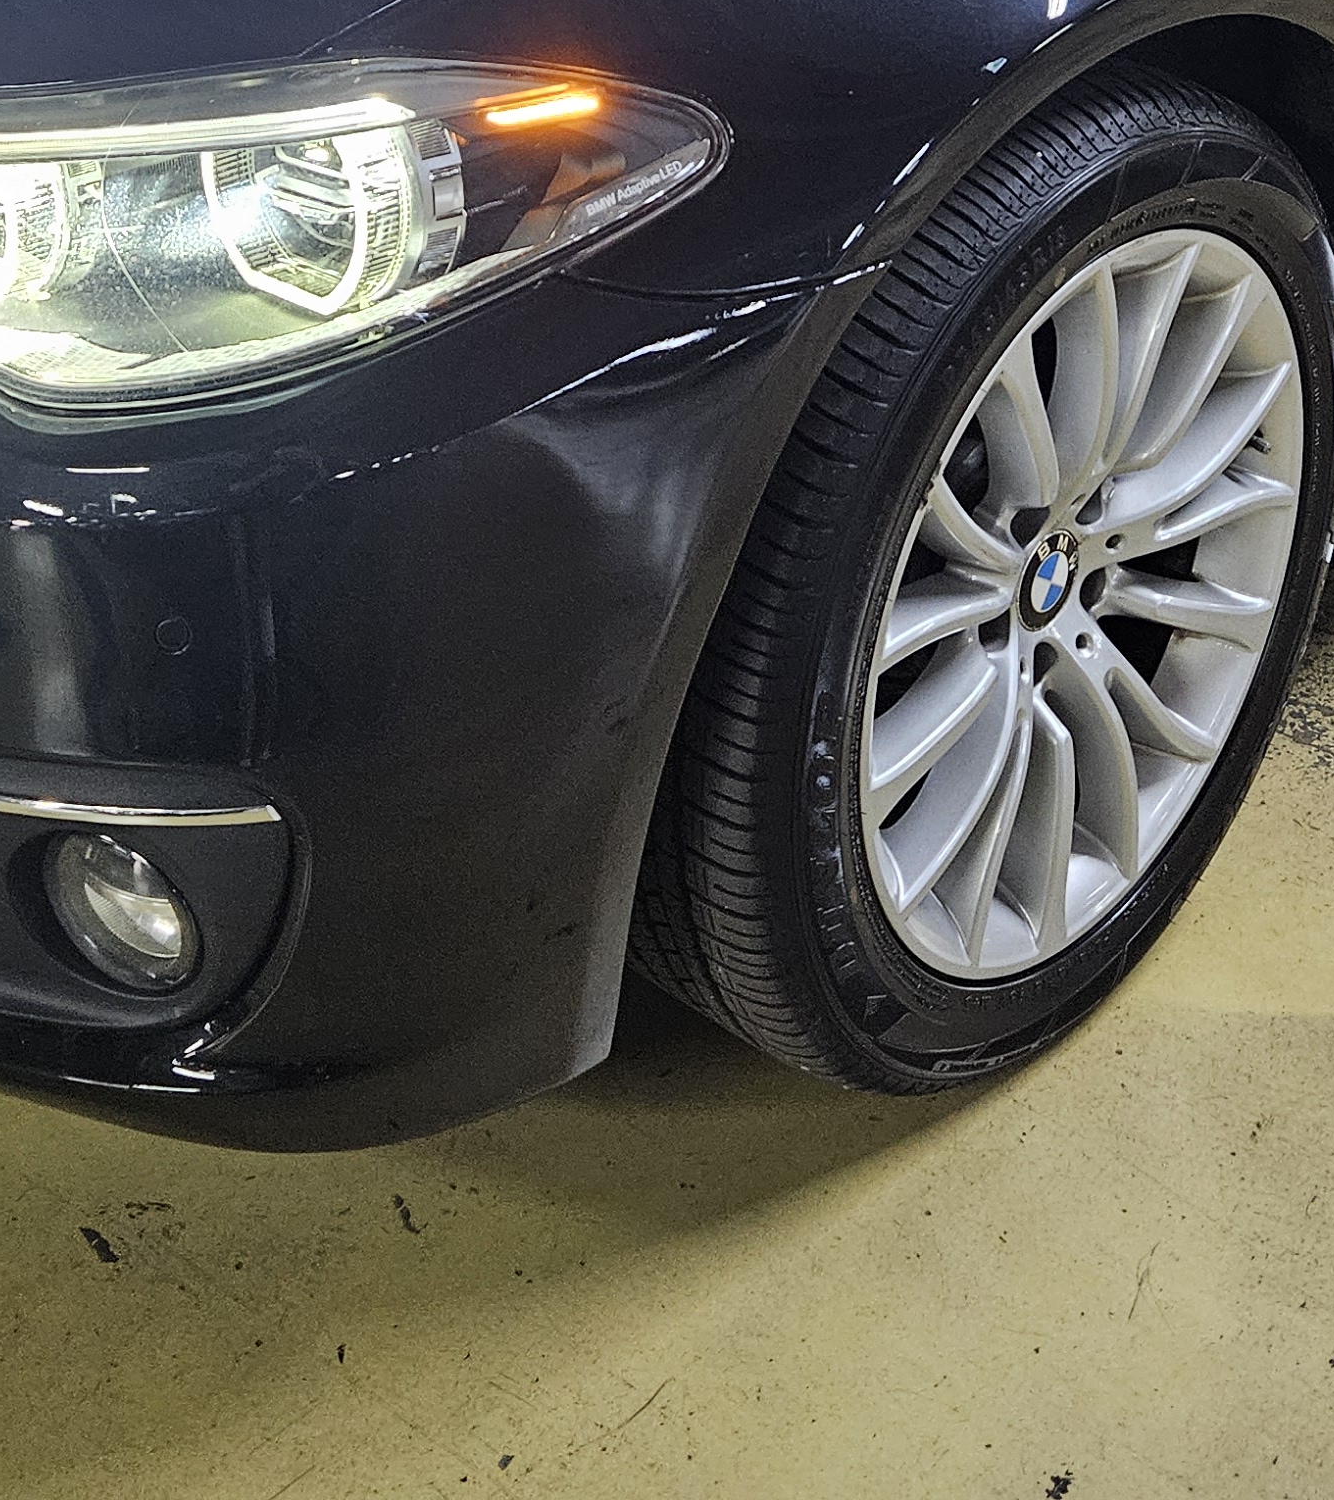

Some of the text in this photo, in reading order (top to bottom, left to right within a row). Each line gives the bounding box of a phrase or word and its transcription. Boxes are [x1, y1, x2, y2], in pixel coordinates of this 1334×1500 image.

[585, 160, 683, 217] BMW Adaptive LED
[1037, 534, 1078, 571] BMW
